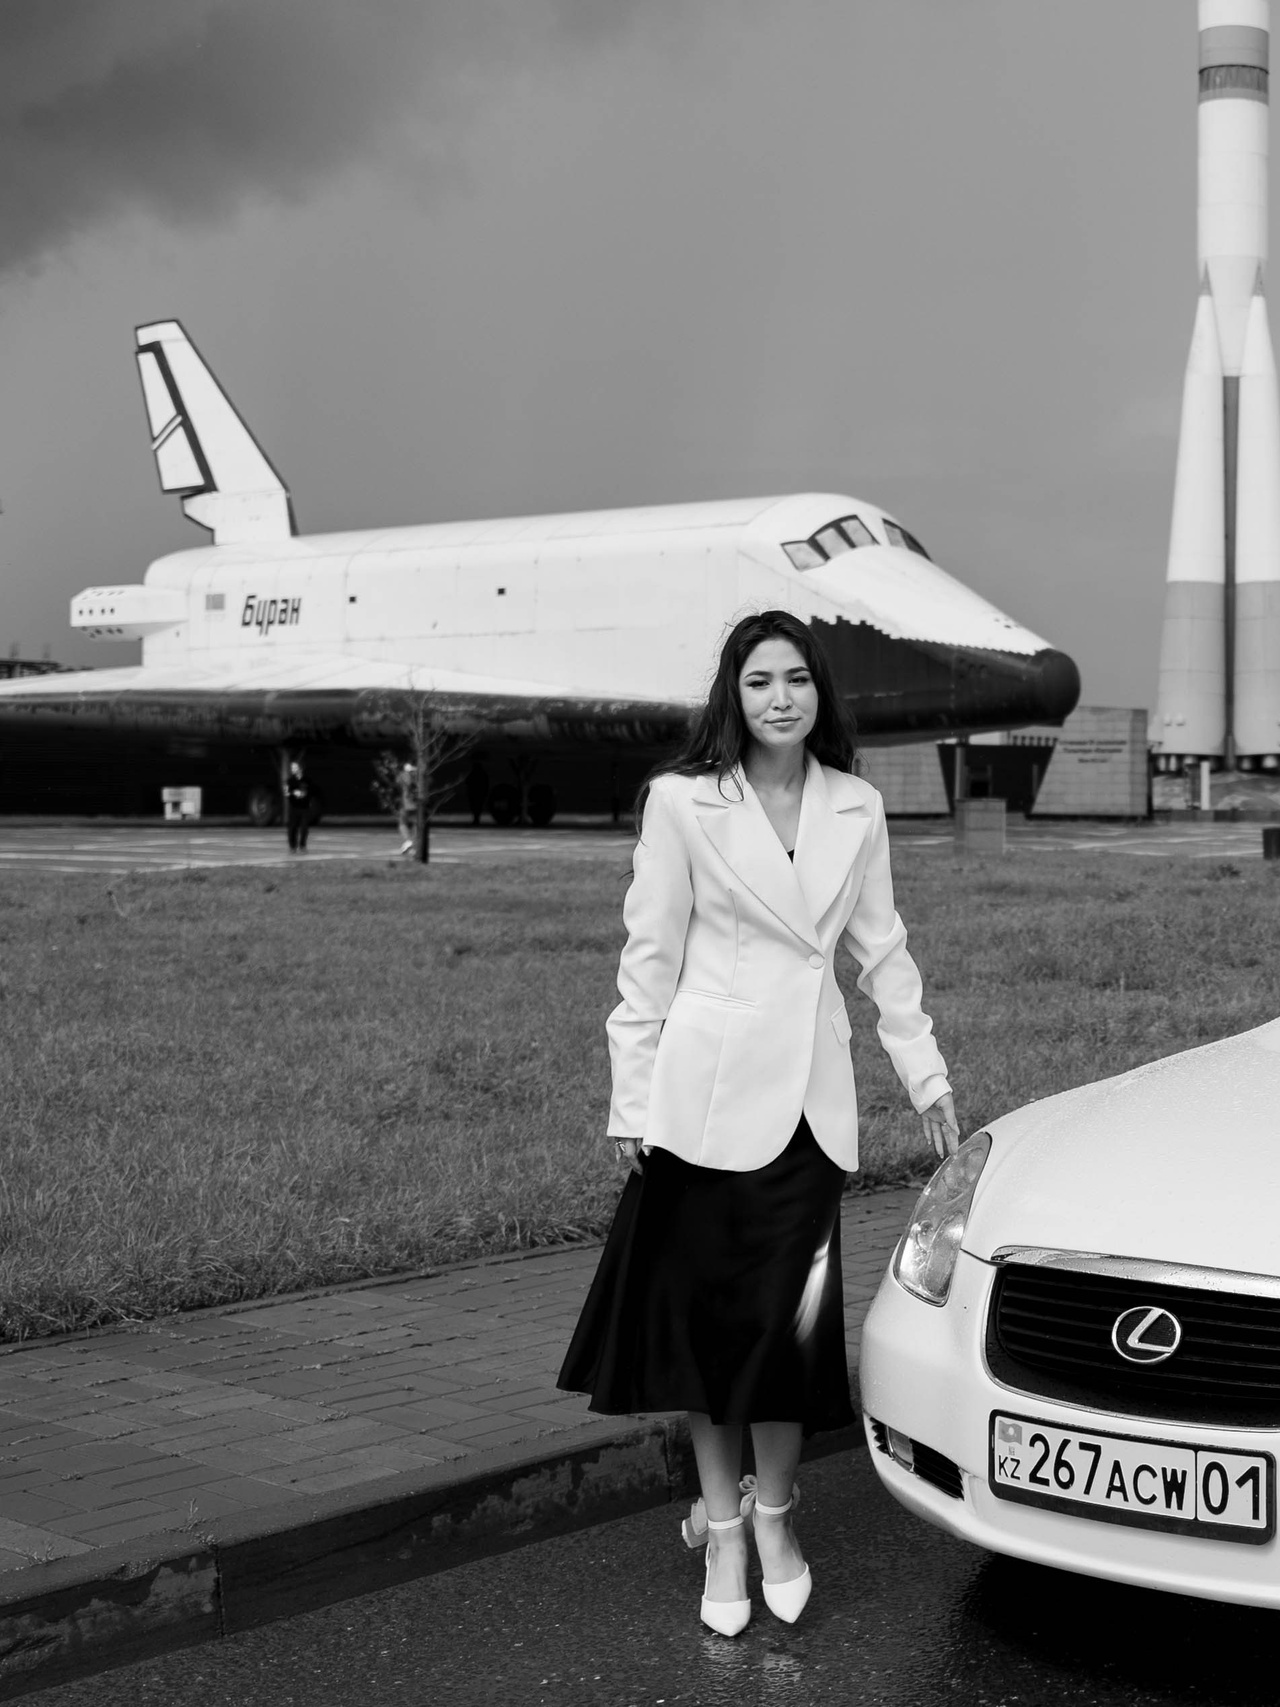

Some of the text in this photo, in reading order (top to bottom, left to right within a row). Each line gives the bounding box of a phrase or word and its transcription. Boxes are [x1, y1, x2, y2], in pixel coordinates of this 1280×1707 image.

[241, 595, 301, 636] Буран
[998, 1454, 1021, 1480] KZ
[1202, 1461, 1261, 1521] 01
